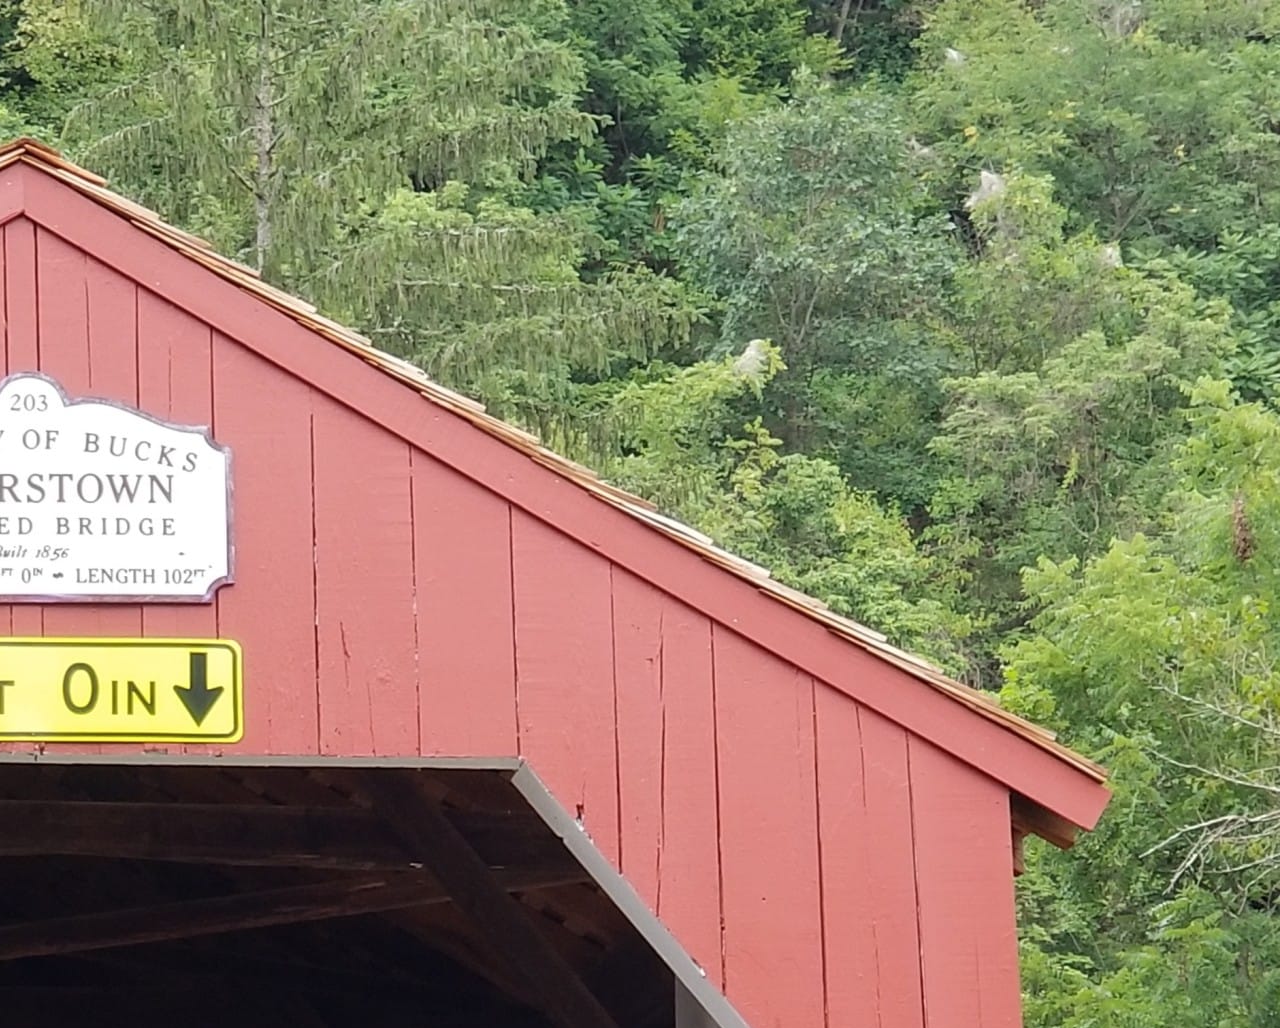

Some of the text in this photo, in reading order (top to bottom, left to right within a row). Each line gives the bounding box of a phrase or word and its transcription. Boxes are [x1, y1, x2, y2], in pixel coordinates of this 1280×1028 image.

[10, 393, 48, 412] 203
[22, 428, 60, 450] OF
[83, 431, 199, 473] BUCKS
[56, 517, 177, 536] BRIDGE
[35, 544, 70, 561] 1856
[76, 567, 156, 584] LENGTH
